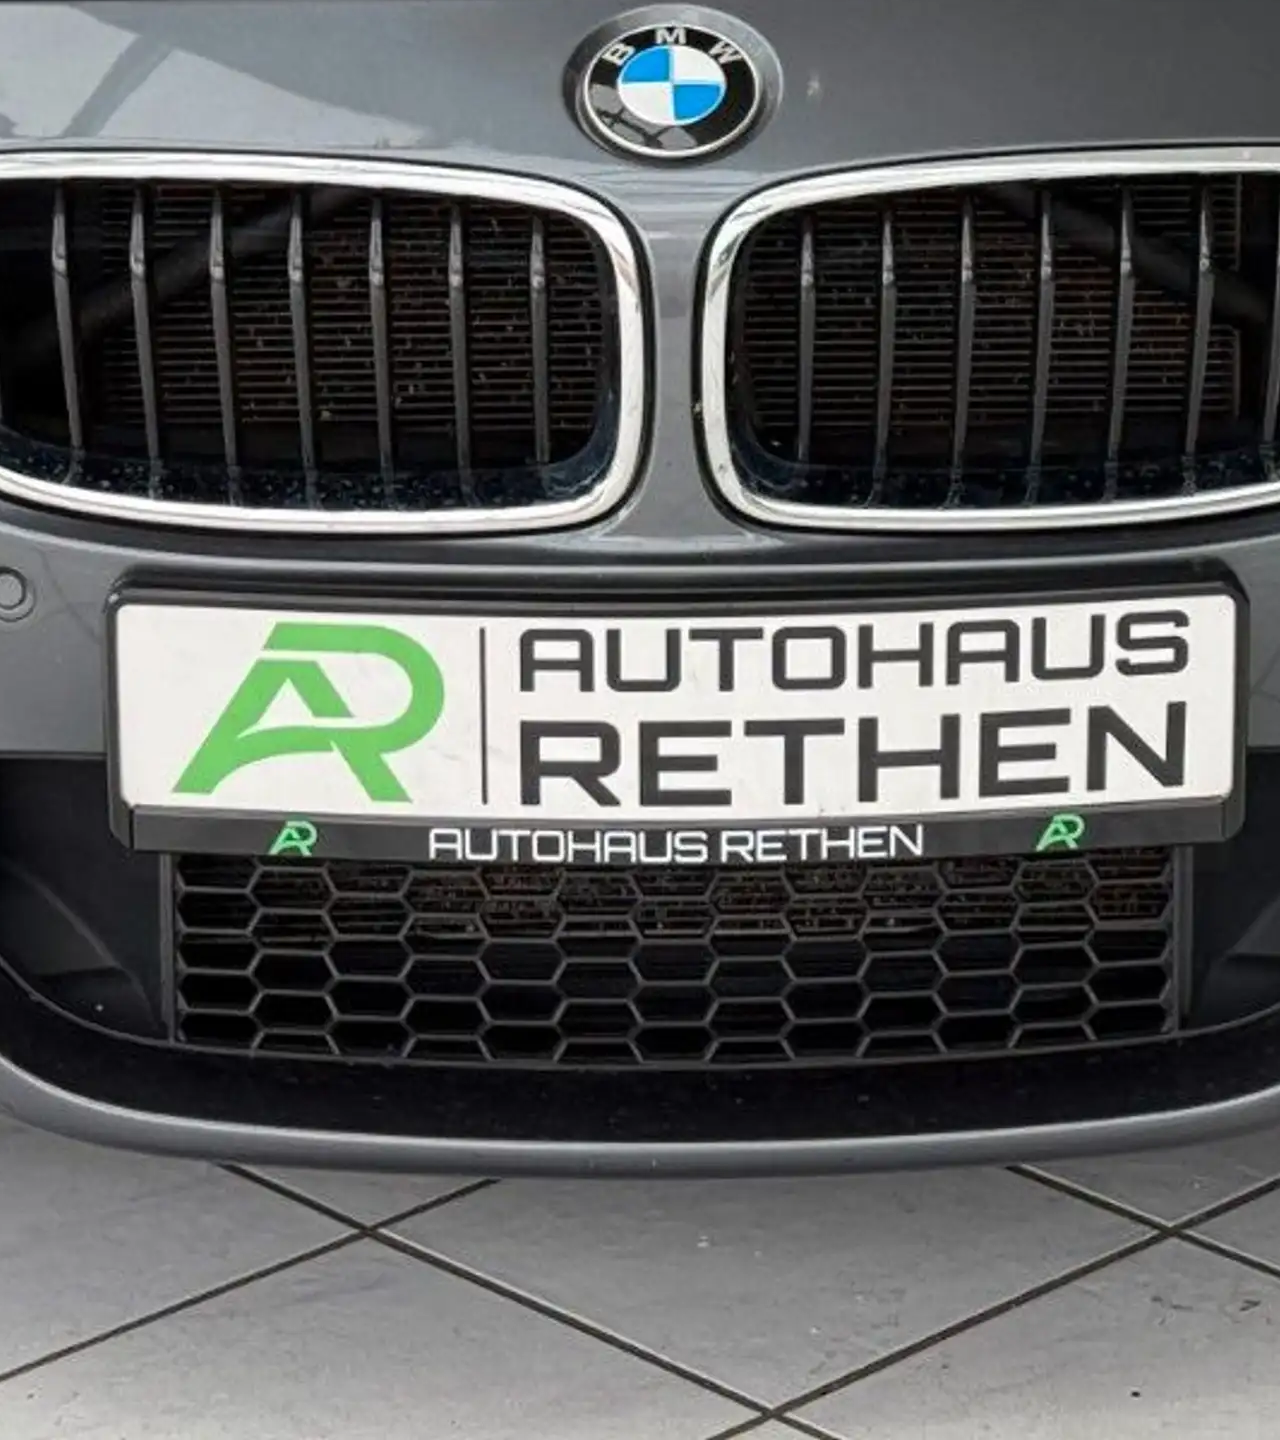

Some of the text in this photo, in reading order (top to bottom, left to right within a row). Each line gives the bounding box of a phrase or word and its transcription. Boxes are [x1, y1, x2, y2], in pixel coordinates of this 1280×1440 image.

[601, 25, 745, 68] BMW
[518, 610, 1190, 693] AUTOHAUS
[518, 701, 1187, 808] RETHEN
[428, 823, 925, 864] AUTOHAUS RETHEN
